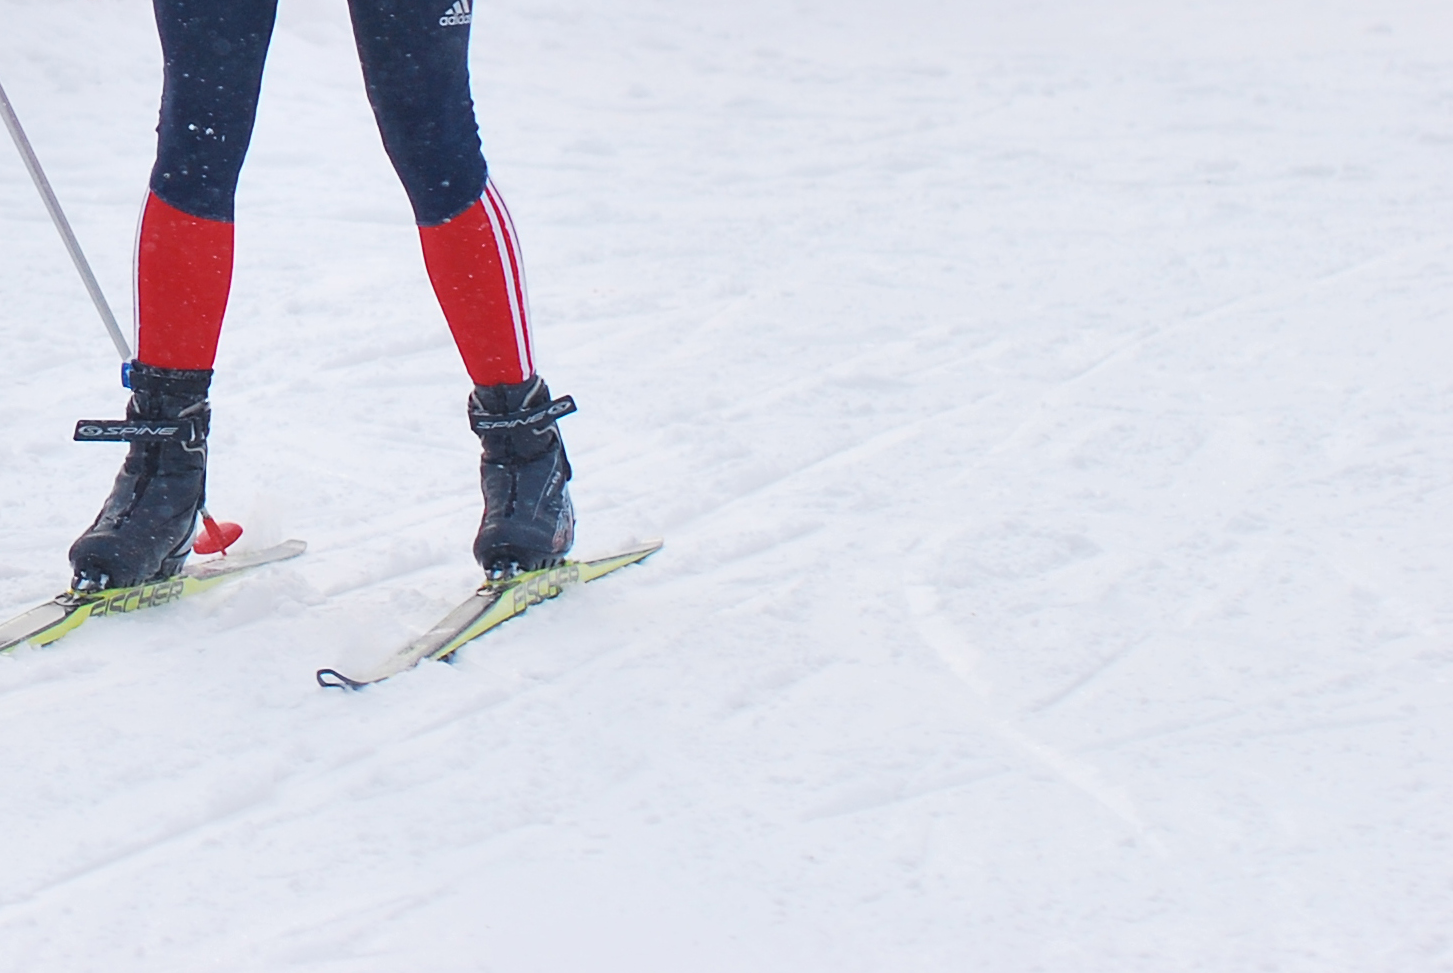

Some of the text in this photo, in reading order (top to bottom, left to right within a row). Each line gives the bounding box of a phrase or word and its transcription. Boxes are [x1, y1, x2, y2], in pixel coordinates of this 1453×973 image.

[475, 410, 547, 430] SPINE
[103, 426, 179, 436] SPINE
[89, 581, 185, 618] FISCHER
